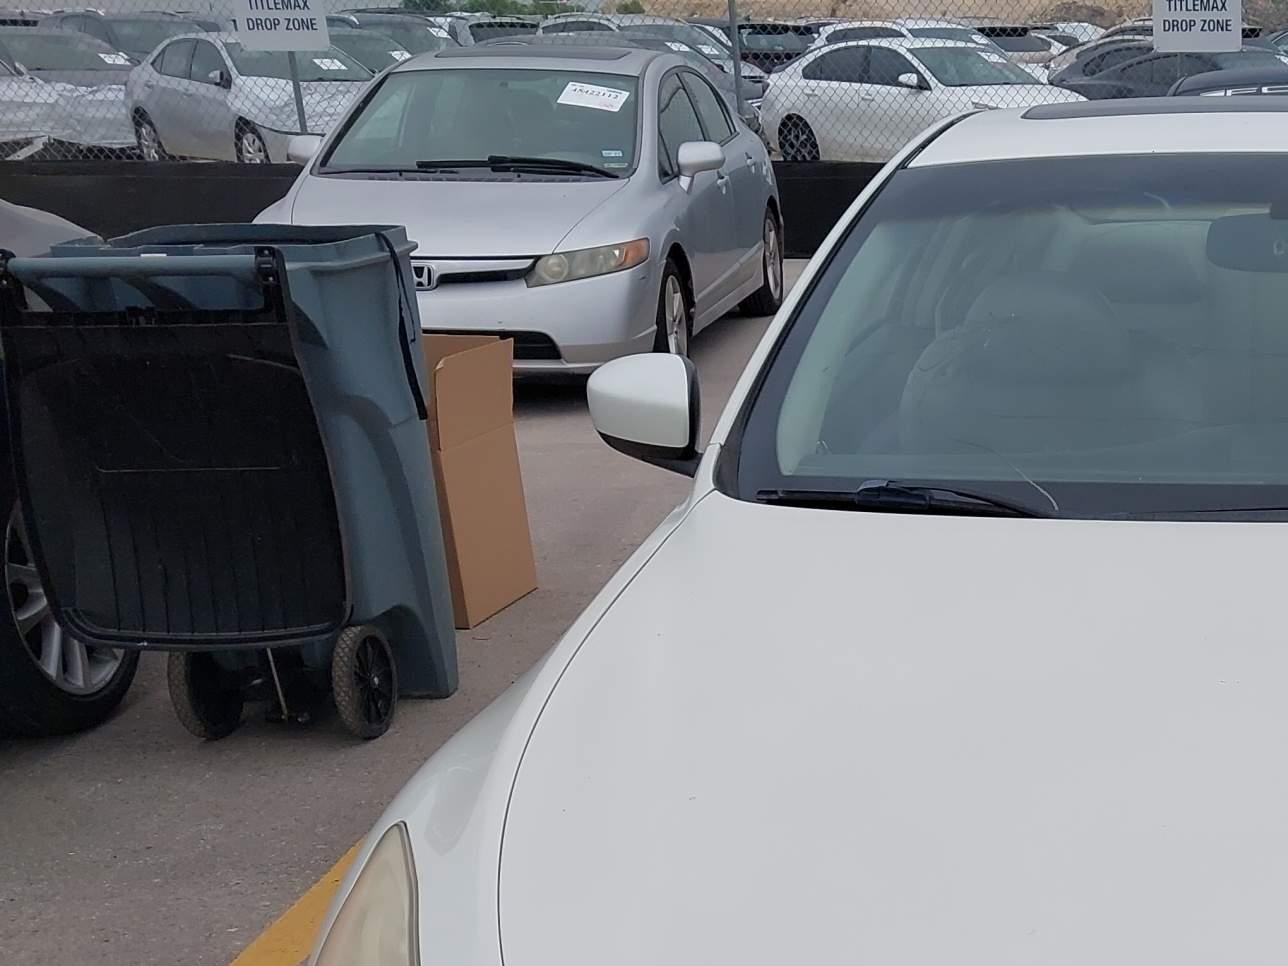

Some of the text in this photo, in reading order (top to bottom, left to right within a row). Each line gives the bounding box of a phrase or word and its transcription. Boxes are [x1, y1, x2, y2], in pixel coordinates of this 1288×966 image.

[248, 0, 310, 10] TITLEMAX
[1166, 0, 1228, 12] TITLEMAX
[246, 17, 318, 31] DROP ZONE
[1162, 19, 1233, 32] DROP ZONE
